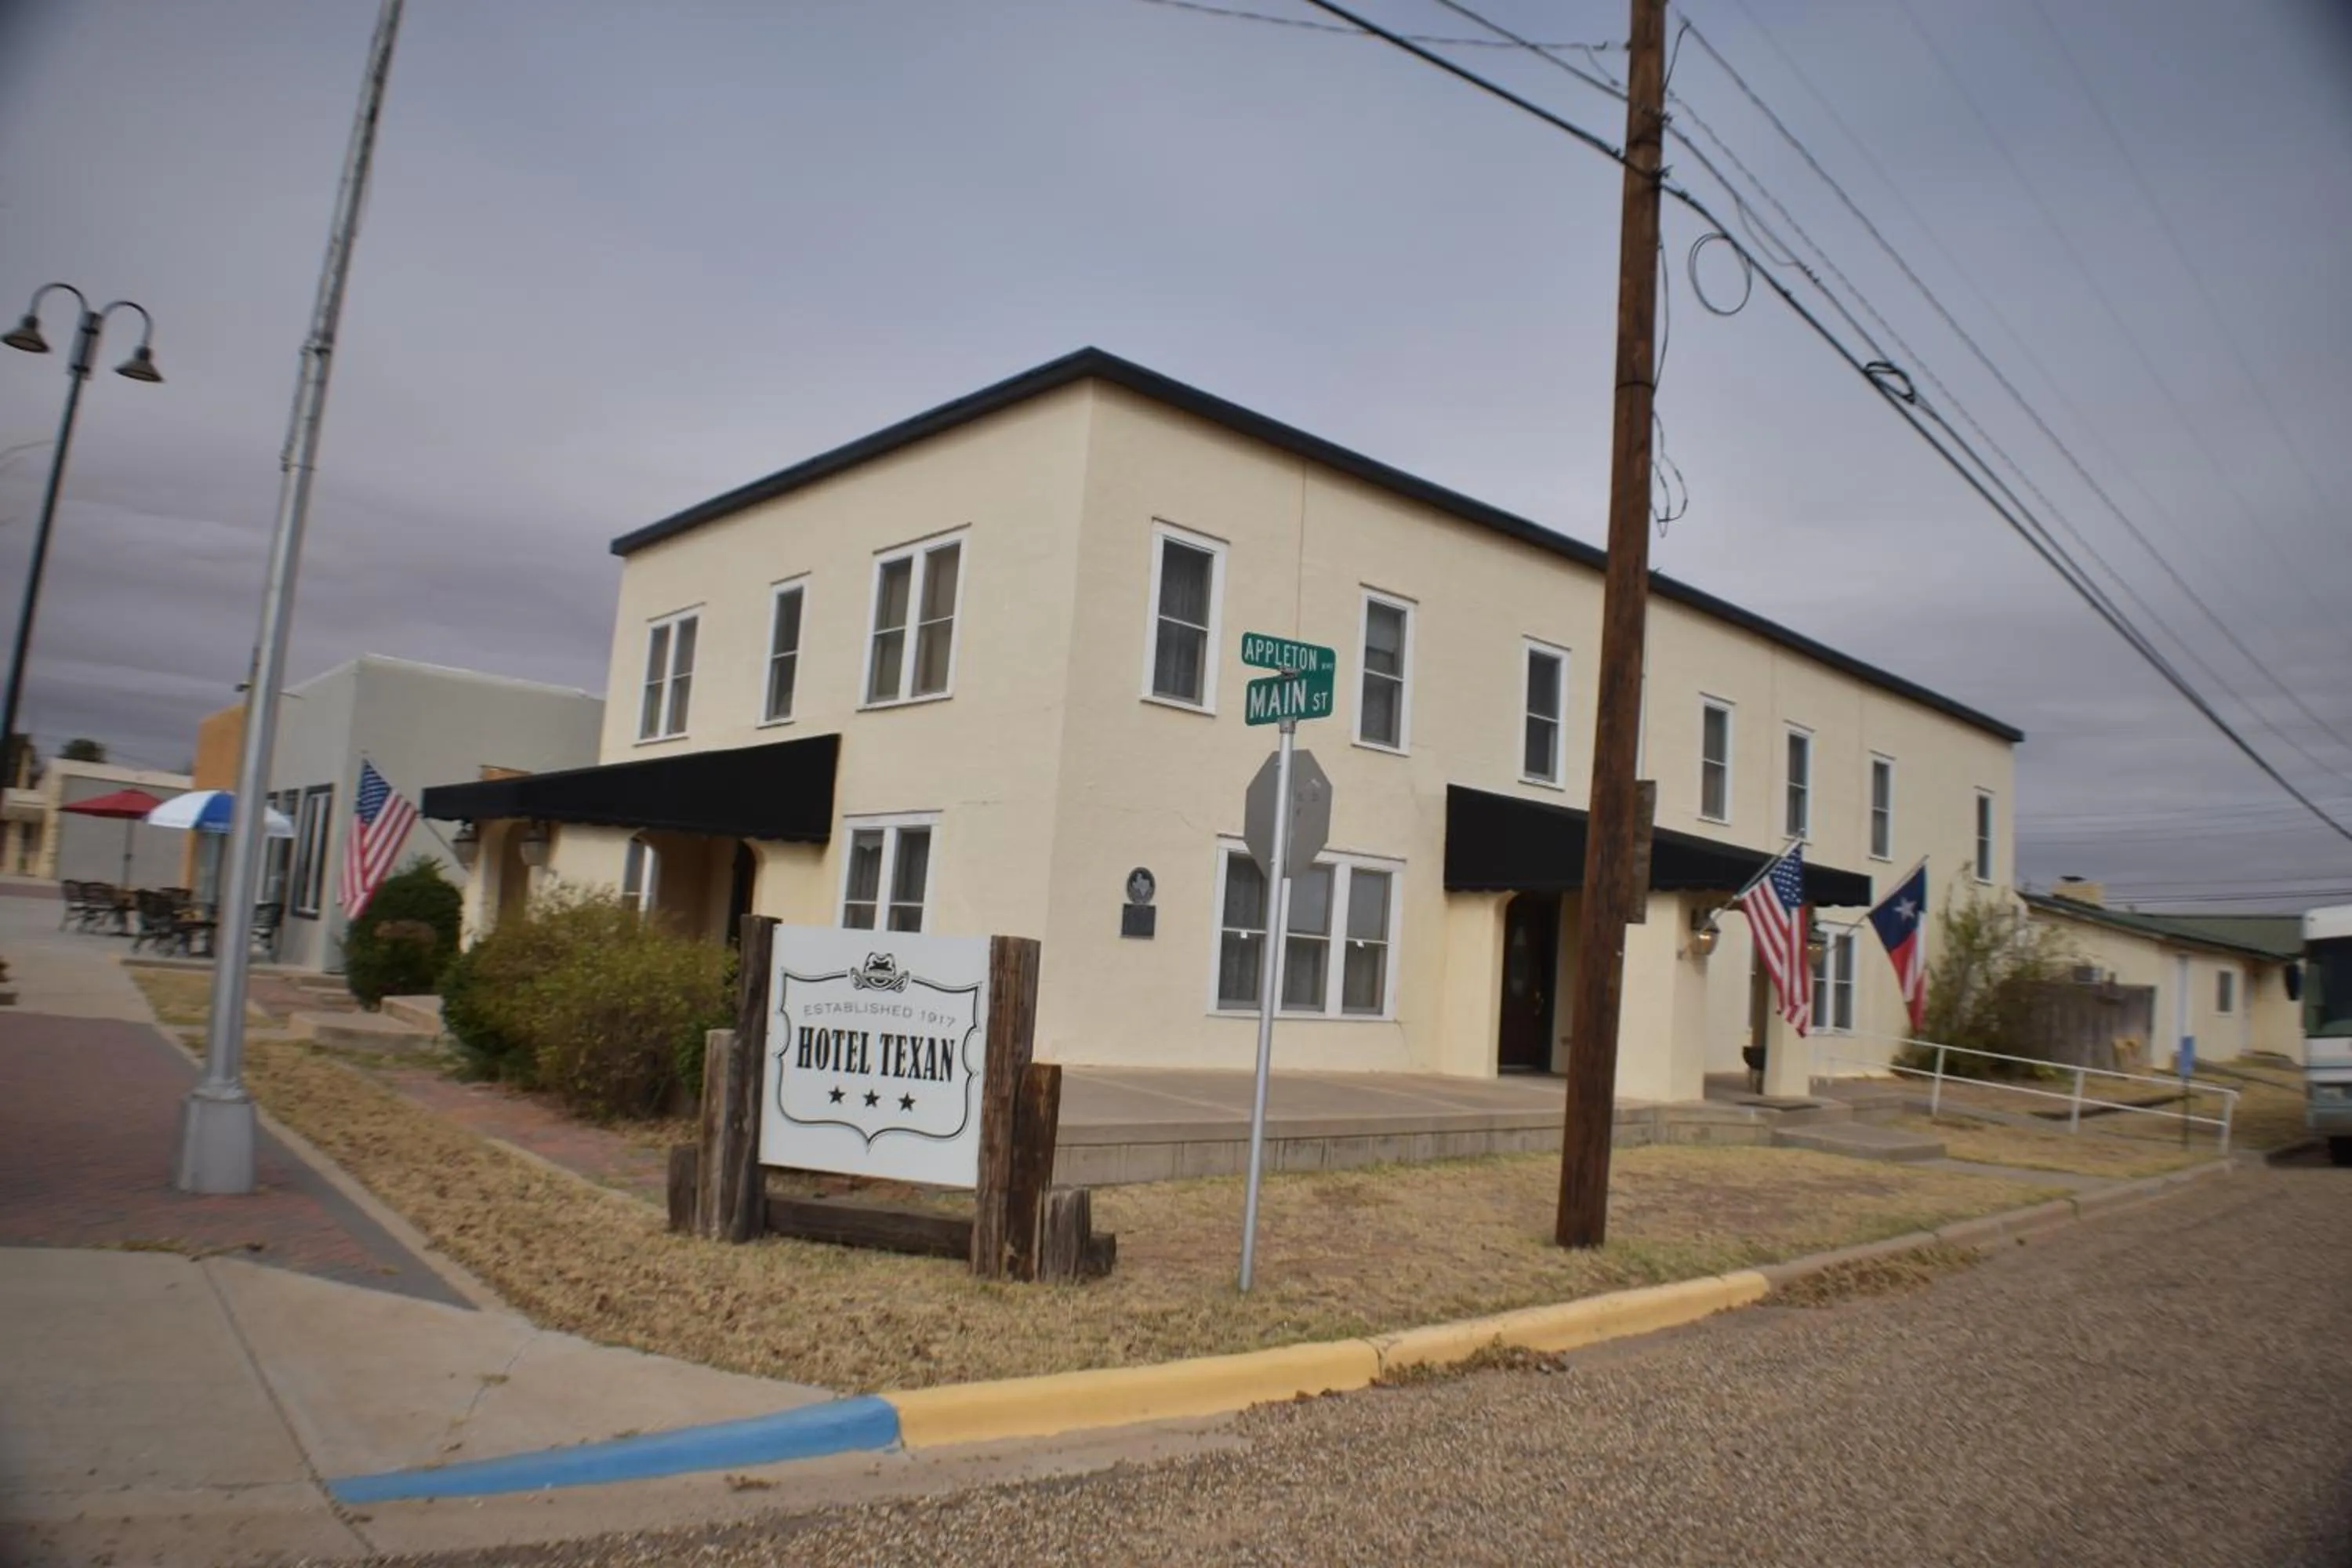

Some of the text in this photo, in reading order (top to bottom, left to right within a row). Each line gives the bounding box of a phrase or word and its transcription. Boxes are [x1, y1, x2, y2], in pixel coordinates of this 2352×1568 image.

[1244, 637, 1317, 671] APPLETON
[1250, 679, 1328, 719] MAIN ST
[804, 1002, 956, 1027] ESTABLISHED 1917
[797, 1026, 956, 1082] HOTEL TEXAN
